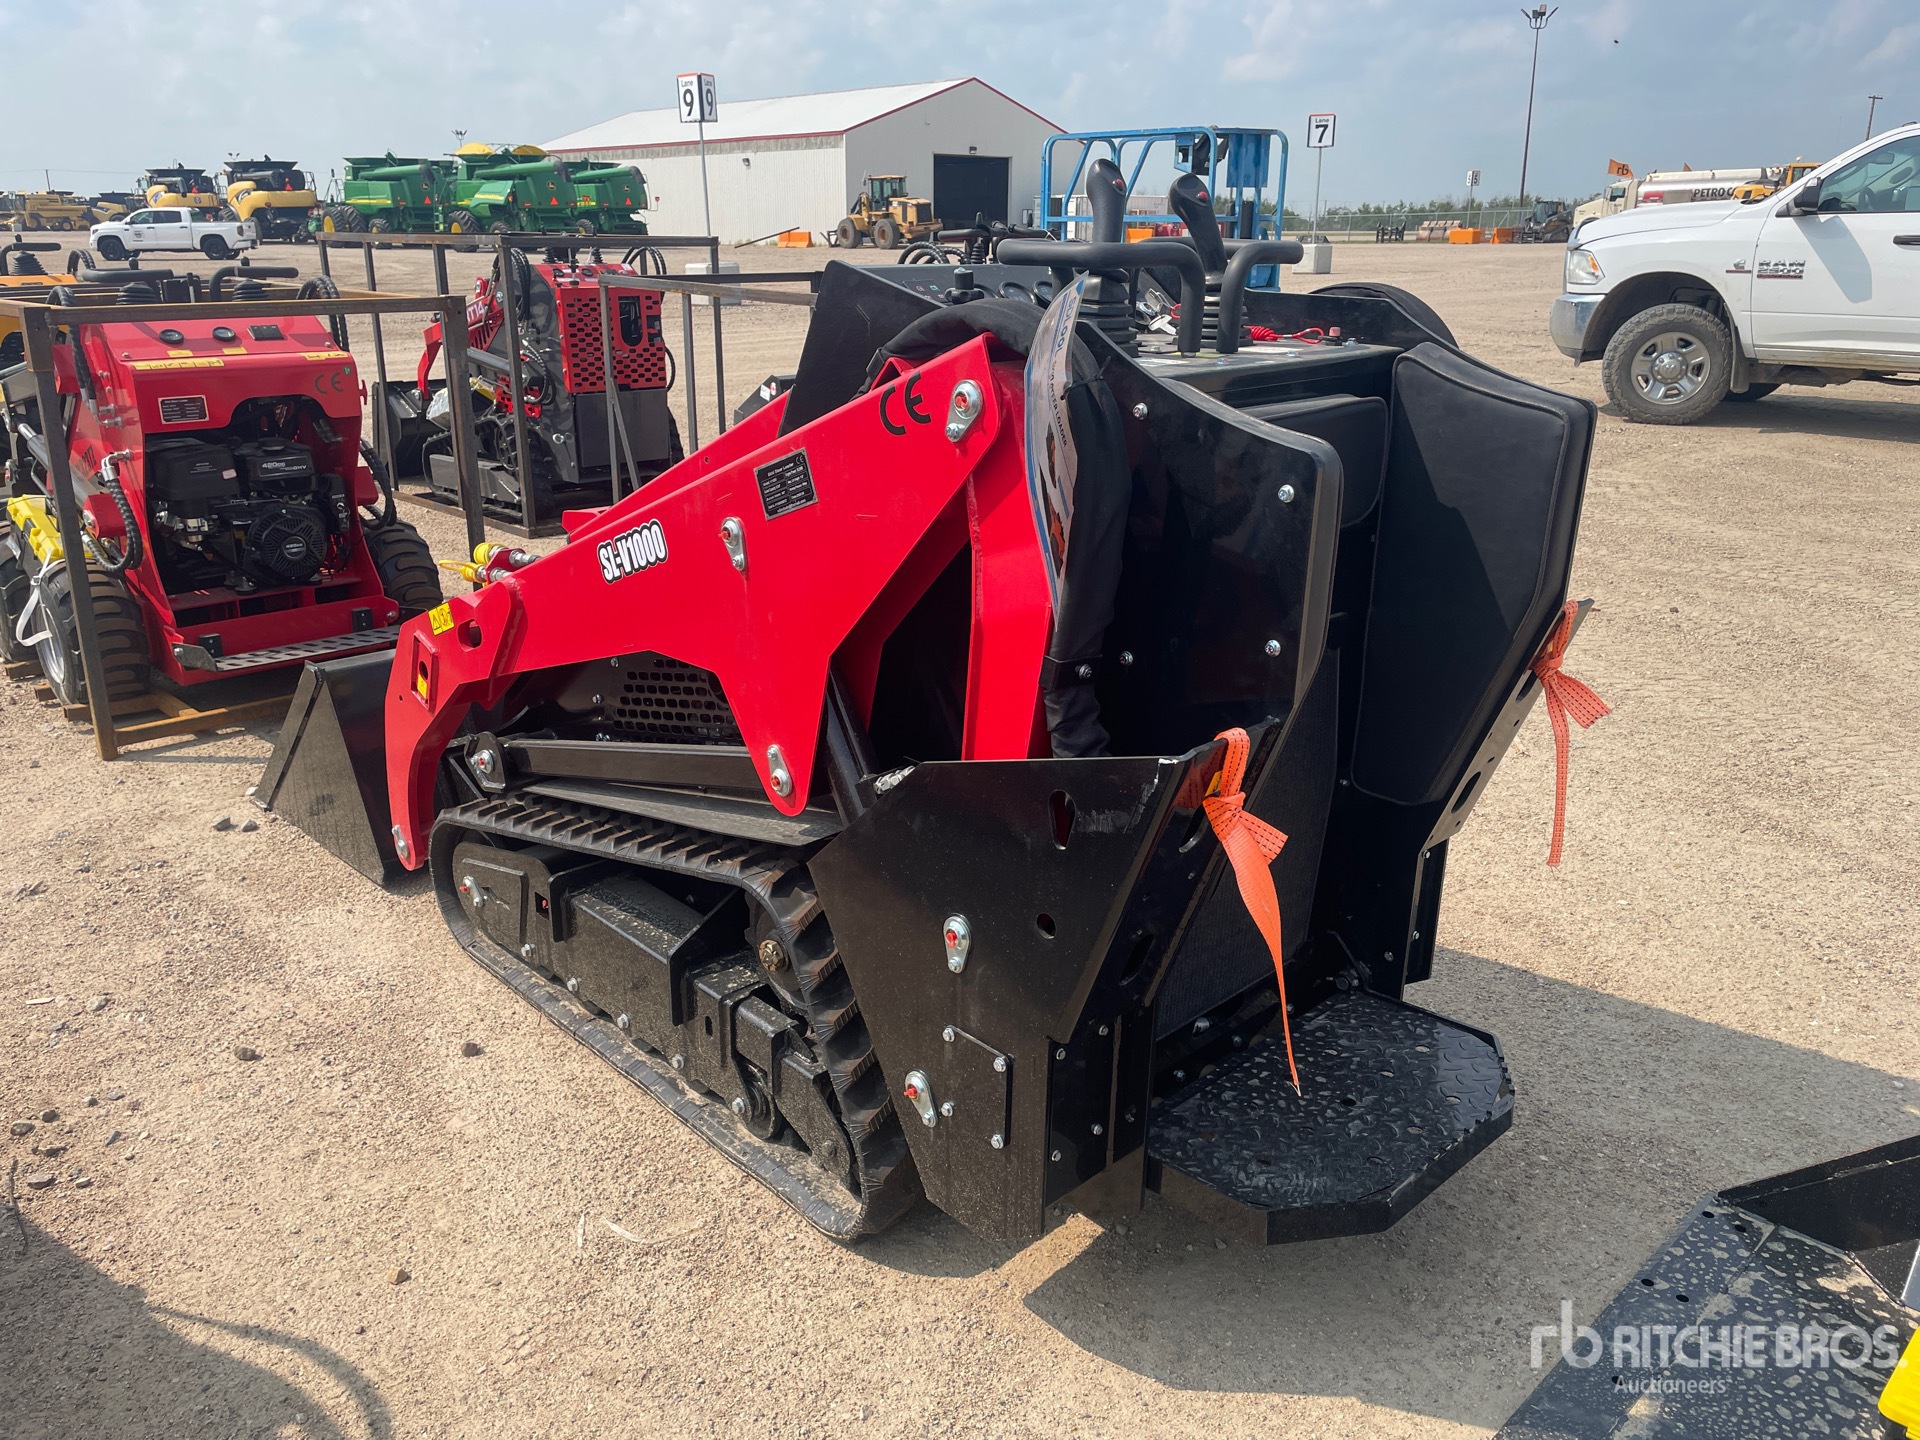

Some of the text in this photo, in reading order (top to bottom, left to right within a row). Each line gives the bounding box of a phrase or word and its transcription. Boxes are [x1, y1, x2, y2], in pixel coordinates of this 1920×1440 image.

[683, 88, 694, 117] 9
[705, 88, 713, 116] 9
[1315, 124, 1329, 144] 7
[1474, 174, 1479, 185] 5
[1757, 267, 1805, 275] 2500
[1758, 259, 1806, 268] RAM
[314, 371, 344, 395] CE
[880, 371, 932, 436] CE
[1054, 411, 1068, 448] LOADER
[598, 520, 667, 583] SL-V1000
